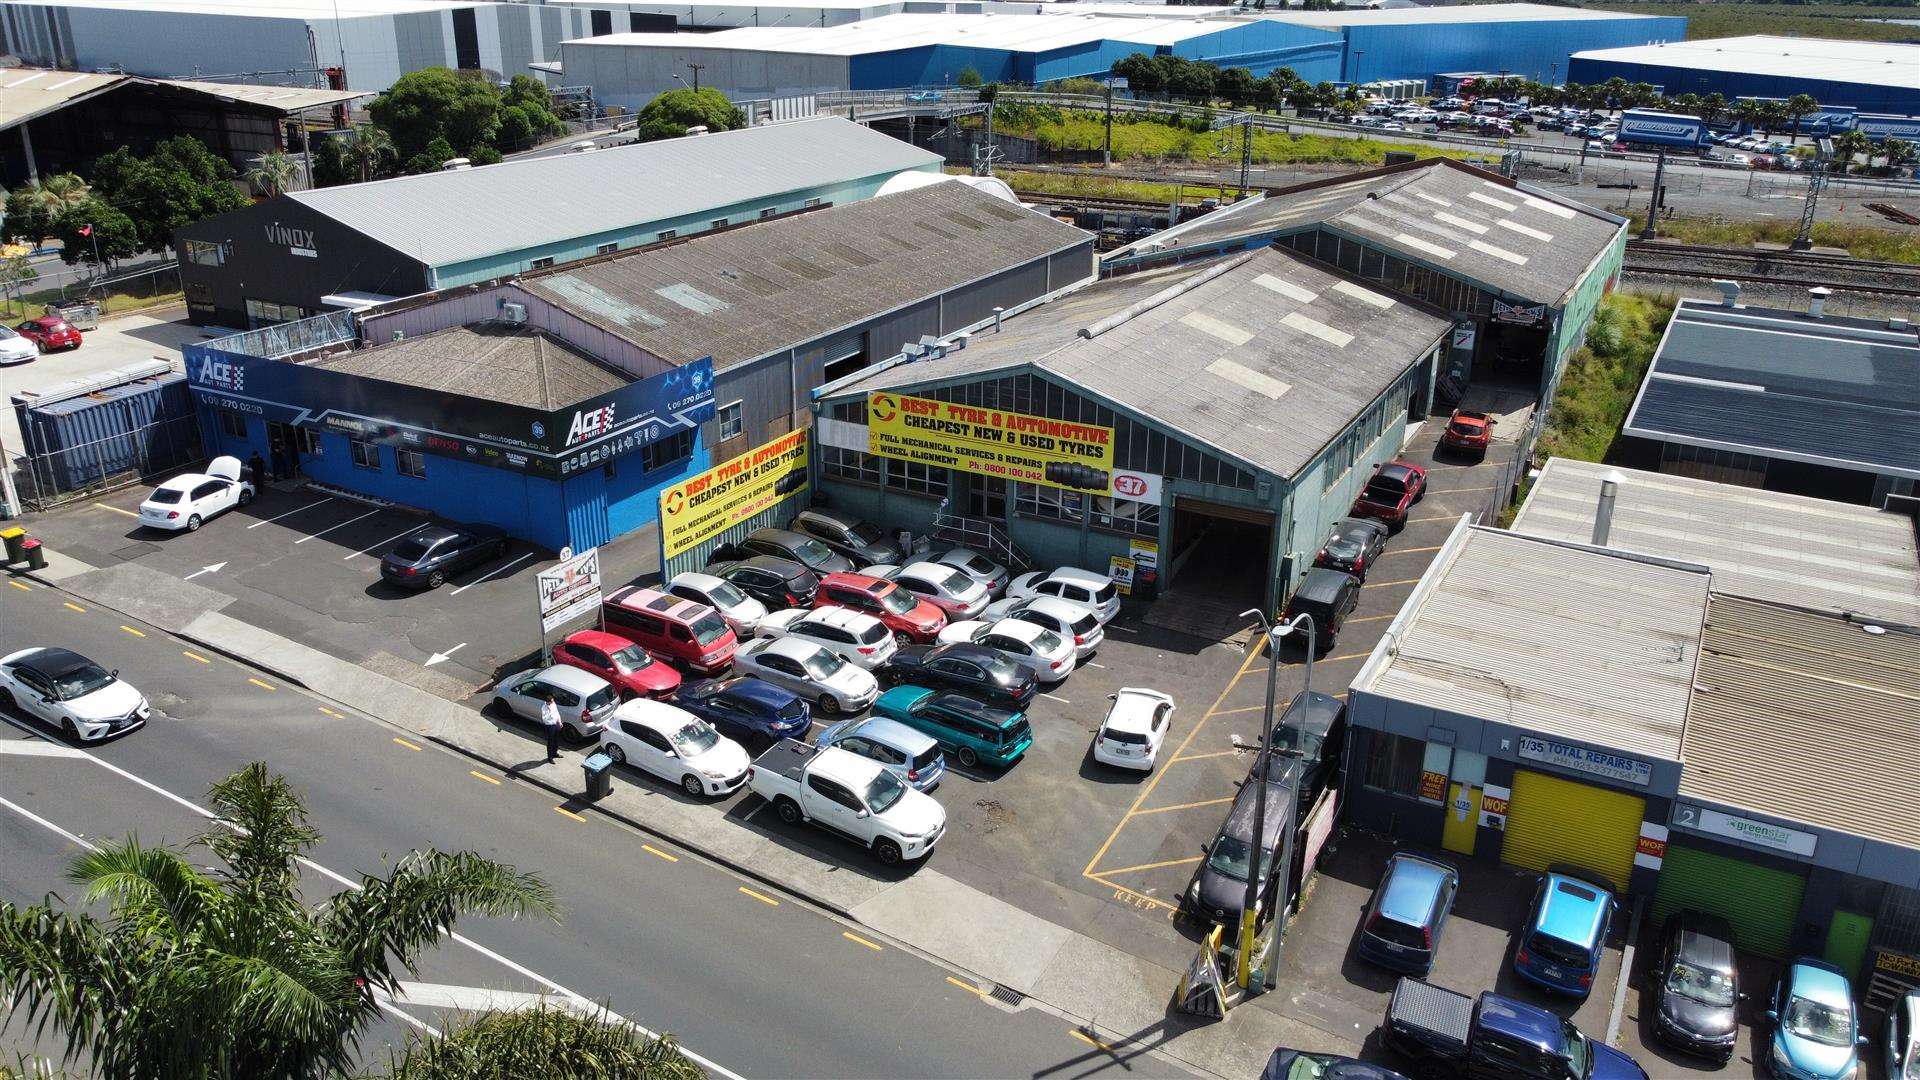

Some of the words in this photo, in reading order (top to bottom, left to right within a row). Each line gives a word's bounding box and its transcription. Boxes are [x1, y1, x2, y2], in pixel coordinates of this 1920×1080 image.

[264, 222, 316, 249] VINOX
[200, 355, 232, 382] ACE
[208, 395, 218, 406] 09
[222, 399, 238, 409] 270
[240, 402, 262, 414] 0220
[673, 400, 681, 409] 09
[683, 396, 695, 406] 270
[327, 416, 364, 430] MANNOL
[534, 426, 542, 434] 39
[565, 410, 602, 446] ACE
[900, 398, 939, 416] BEST
[948, 406, 987, 424] TYRE
[992, 413, 1001, 427] &
[1006, 416, 1109, 444] AUTOMOTIVE
[479, 432, 550, 452] aceautoparts.co.nz
[904, 415, 970, 436] CHEAPEST
[974, 426, 1003, 442] NEW
[1007, 432, 1015, 444] &
[1020, 433, 1054, 450] USED
[1059, 440, 1104, 458] TYRES
[880, 433, 899, 444] FULL
[902, 437, 952, 452] MECHANICAL
[955, 446, 994, 460] SERVICES
[1006, 453, 1042, 468] REPAIRS
[880, 445, 908, 456] WHEEL
[910, 450, 958, 466] ALIGNMENT
[686, 472, 712, 497] BEST
[717, 460, 742, 483] TYRE
[752, 431, 806, 466] AUTOMOTIVE
[969, 460, 982, 470] Ph:
[984, 464, 1006, 474] 0800
[1008, 467, 1023, 476] 100
[1025, 470, 1042, 481] 042
[689, 479, 732, 508] CHEAPEST
[734, 470, 751, 487] NEW
[754, 465, 758, 477] &
[760, 458, 780, 475] USED
[781, 445, 804, 464] TYRES
[1120, 478, 1143, 494] 37
[673, 524, 687, 536] FULL
[688, 508, 722, 529] MECHANICAL
[723, 494, 748, 512] SERVICES
[753, 482, 774, 497] REPAIRS
[673, 536, 694, 549] WHEEL
[695, 518, 726, 538] ALIGNMENT
[562, 550, 570, 560] 37
[1520, 740, 1544, 752] 1/35
[1548, 742, 1582, 760] TOTAL
[1586, 752, 1632, 771] REPAIRS
[1423, 772, 1446, 784] FREE
[1484, 798, 1507, 812] WOF
[1682, 810, 1694, 825] 2
[1737, 822, 1791, 841] greenstar
[1640, 839, 1664, 850] WOF
[1114, 890, 1156, 910] KEEP
